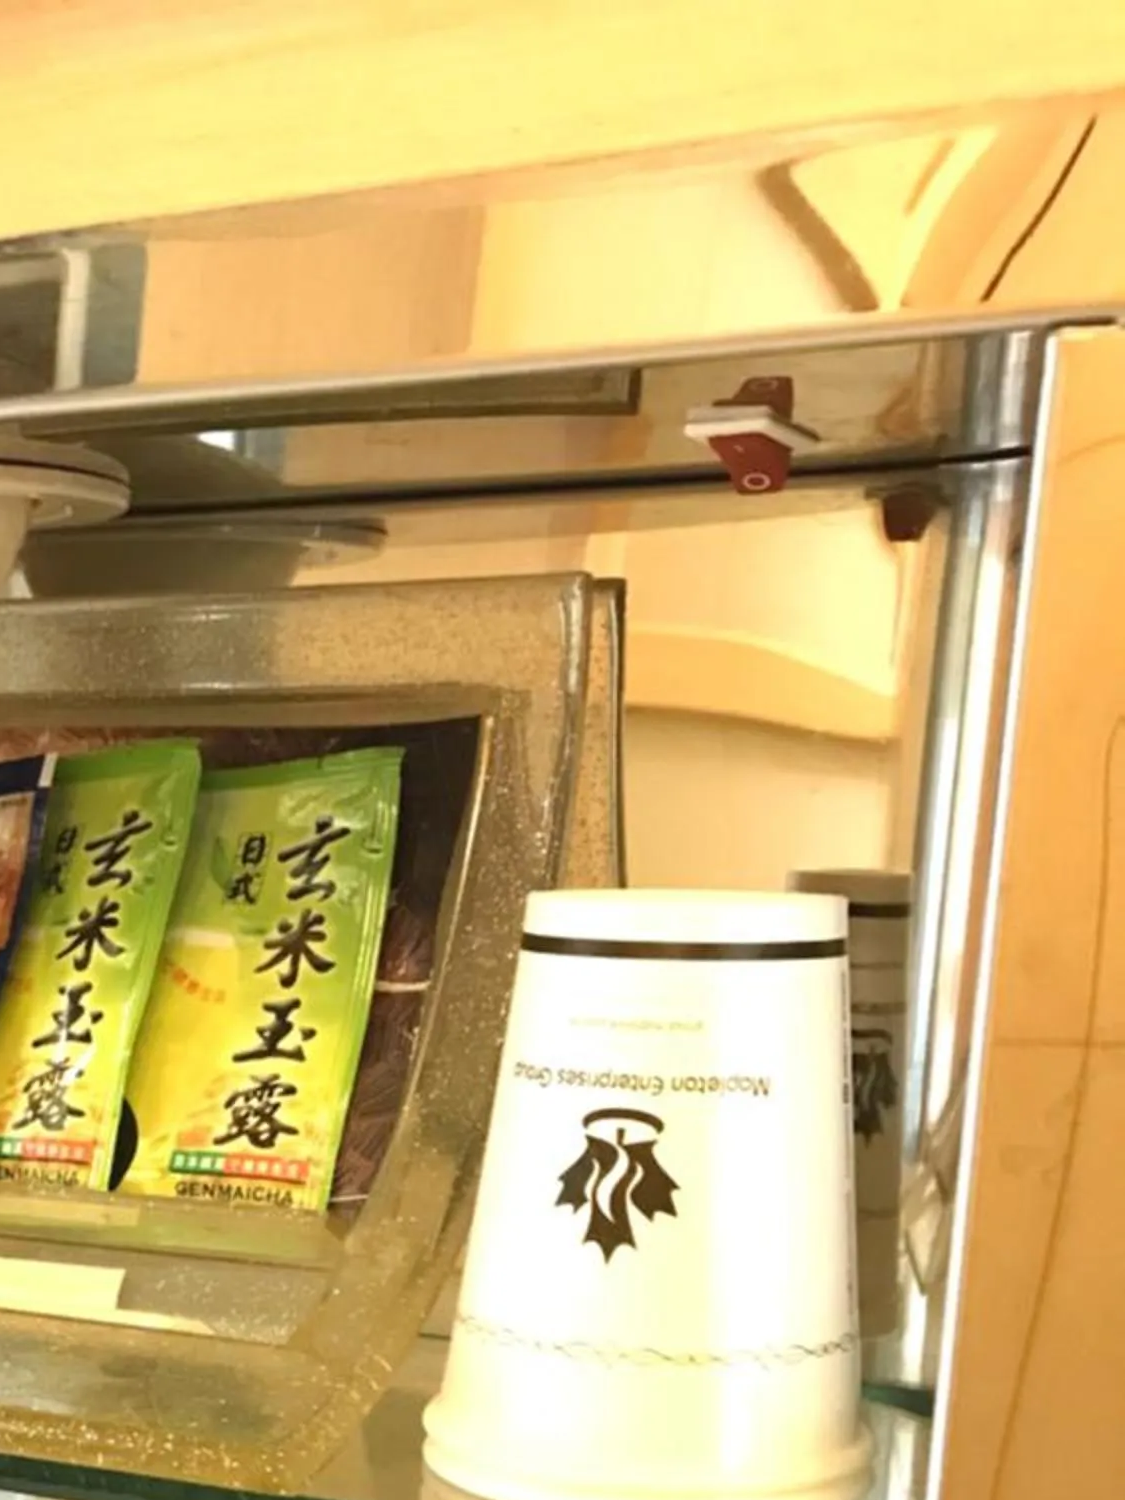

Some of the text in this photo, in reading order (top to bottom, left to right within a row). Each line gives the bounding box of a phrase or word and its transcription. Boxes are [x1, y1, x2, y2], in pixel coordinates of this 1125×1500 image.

[11, 810, 153, 1132] 玄米玉露
[213, 815, 352, 1149] 玄米玉露
[556, 1067, 665, 1097] Enterprises
[174, 1180, 294, 1209] GENMAICHA
